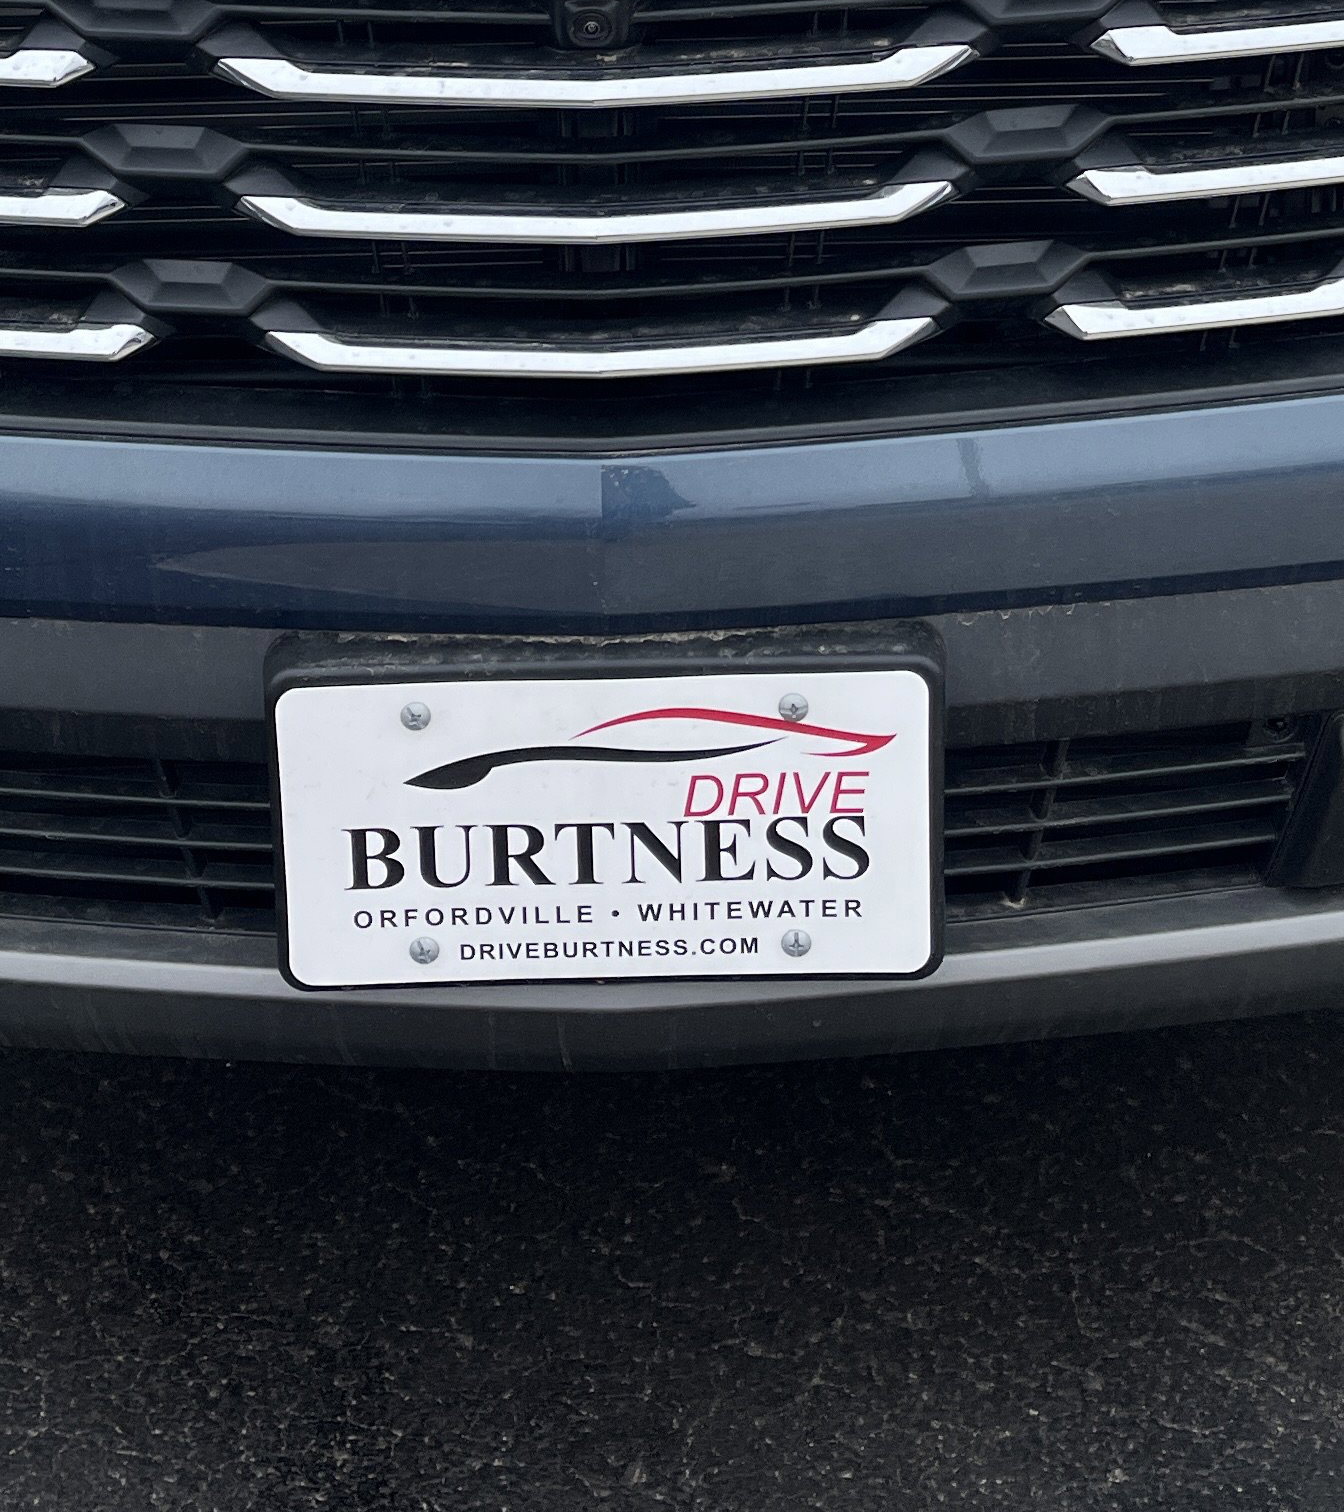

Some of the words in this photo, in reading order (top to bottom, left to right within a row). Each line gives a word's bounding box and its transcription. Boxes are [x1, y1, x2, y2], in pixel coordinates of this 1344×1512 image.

[683, 770, 870, 818] DRIVE
[342, 815, 870, 891] BURTNESS
[353, 905, 593, 929] ORFORDVILLE
[637, 899, 863, 922] WHITEWATER
[460, 937, 758, 961] DRIVEBURTNESS.COM
